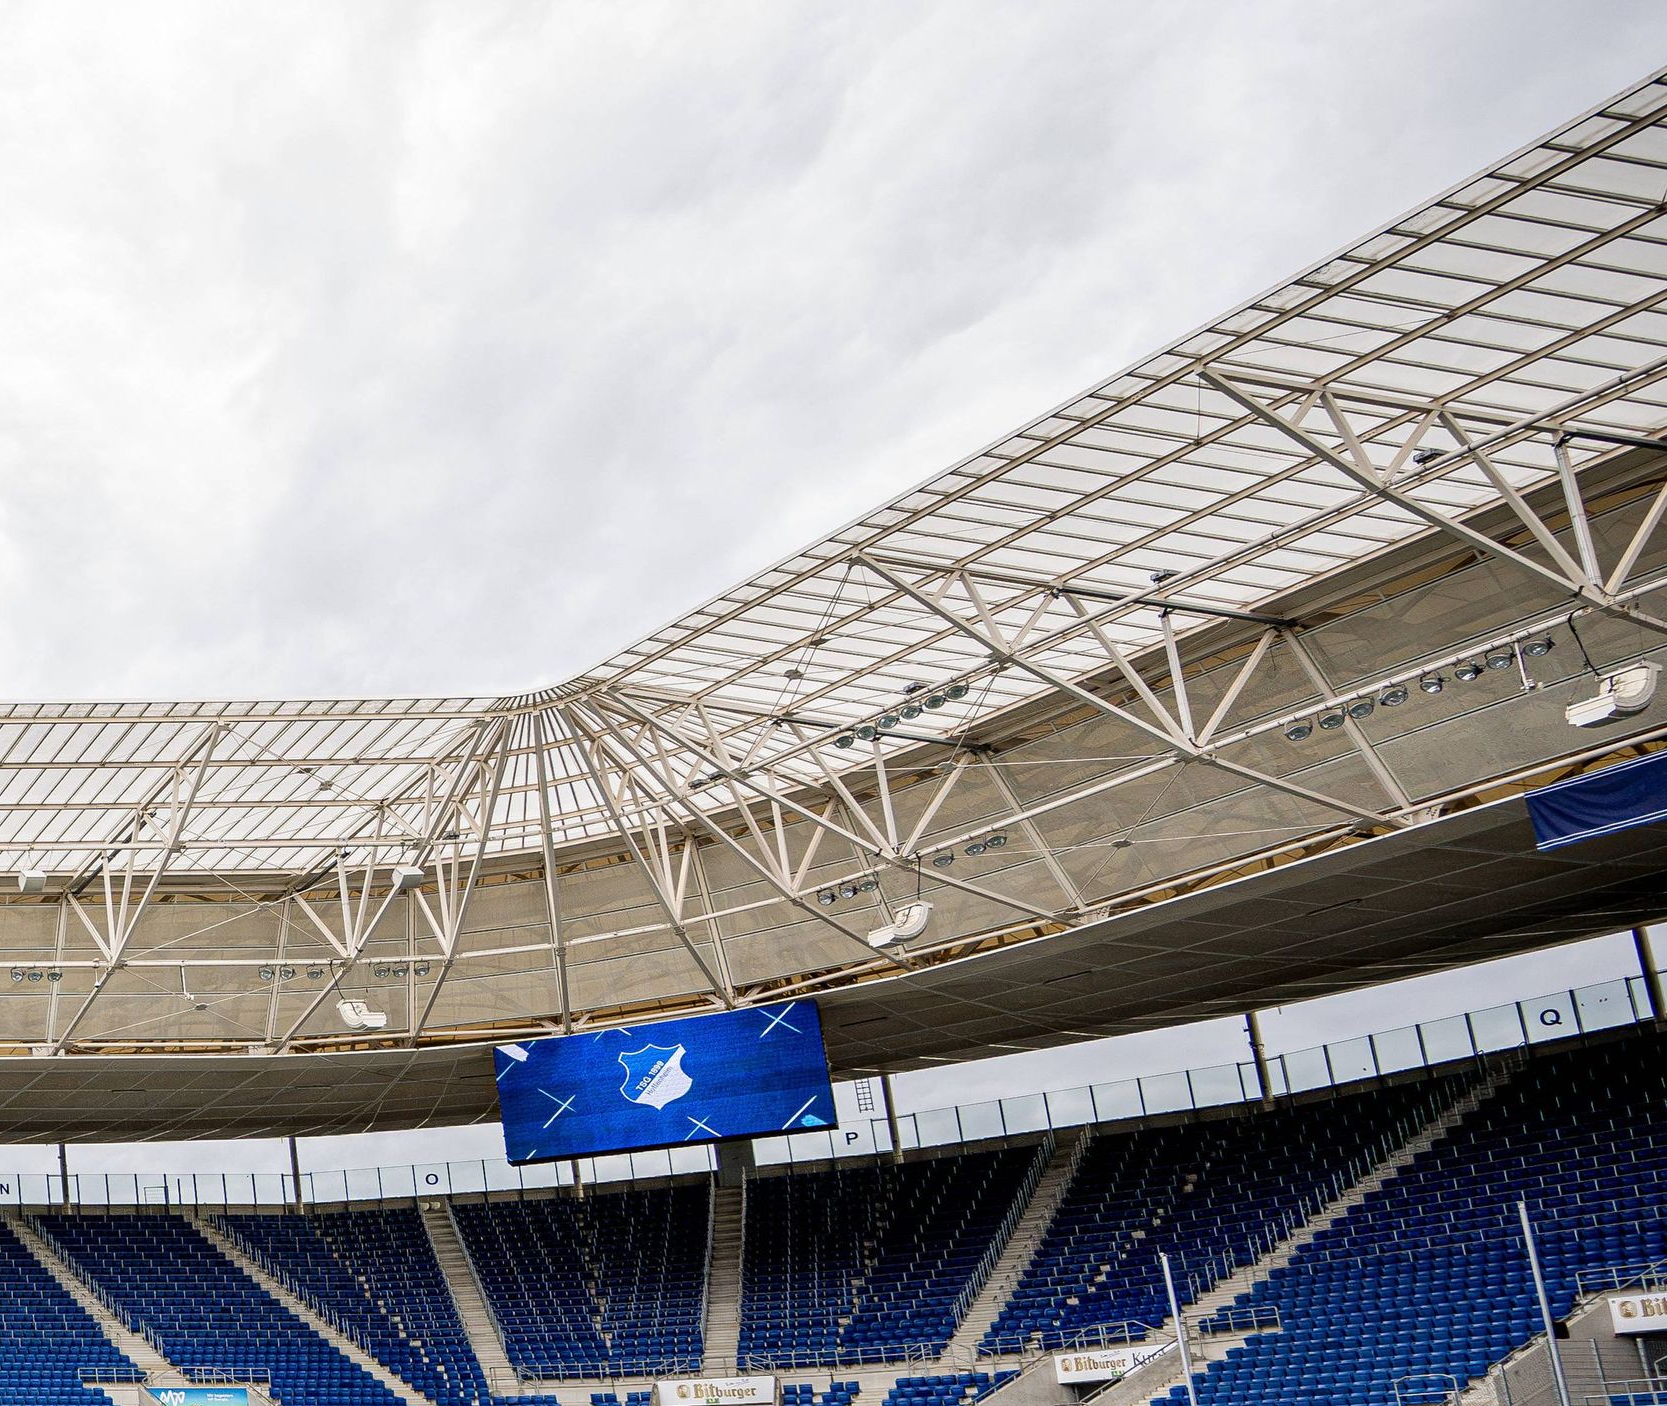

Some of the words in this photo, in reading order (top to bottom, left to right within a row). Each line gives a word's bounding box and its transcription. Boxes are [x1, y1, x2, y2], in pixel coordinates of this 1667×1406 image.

[1540, 1009, 1562, 1026] Q
[635, 1076, 652, 1091] TSG
[846, 1132, 859, 1145] P
[425, 1173, 438, 1185] O
[0, 1183, 10, 1195] N
[1073, 1356, 1126, 1372] Bitburger
[694, 1383, 757, 1399] Bitburger
